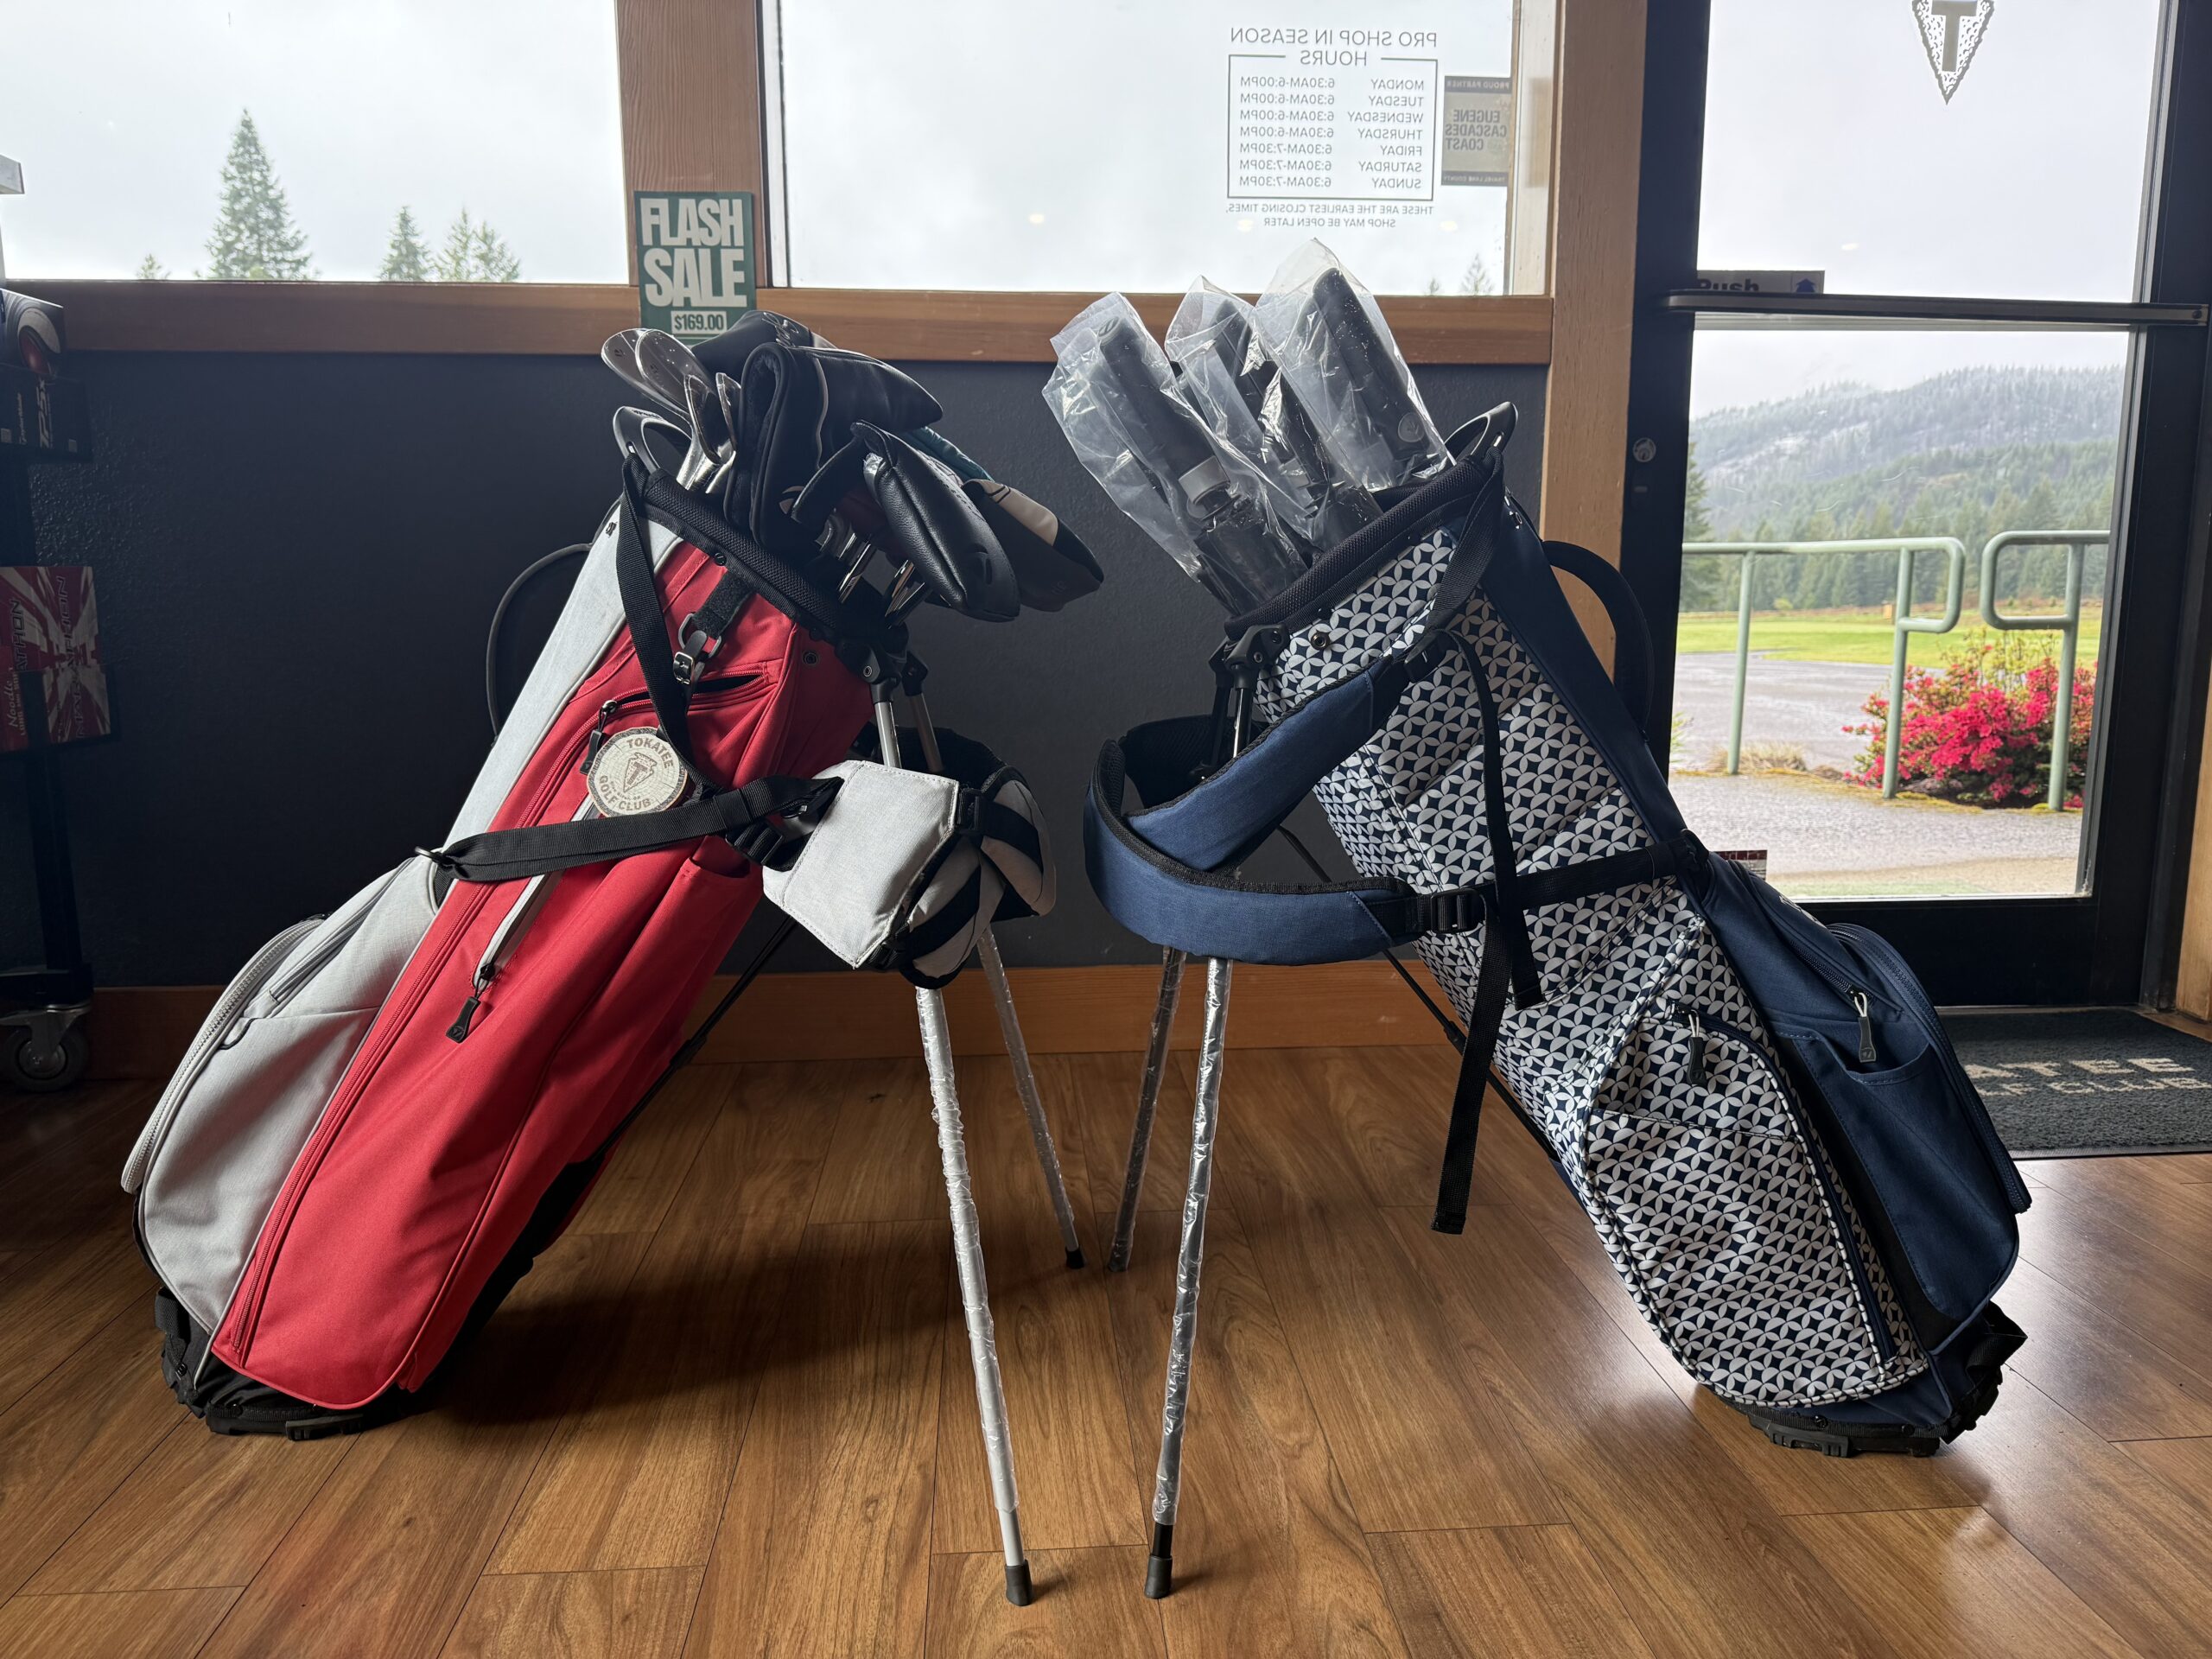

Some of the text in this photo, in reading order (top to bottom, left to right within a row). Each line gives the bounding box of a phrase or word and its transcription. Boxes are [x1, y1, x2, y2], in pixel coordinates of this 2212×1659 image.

[640, 198, 744, 246] FLASH
[644, 248, 747, 308] SALE
[674, 314, 724, 331] $169.00
[10, 598, 28, 671] ATHON
[3, 680, 18, 728] Noodle
[626, 737, 674, 769] TOKATEE
[600, 775, 619, 804] GOLF
[619, 798, 651, 811] CLUB
[1962, 1057, 2196, 1079] ATEE
[1975, 1082, 2040, 1096] LF
